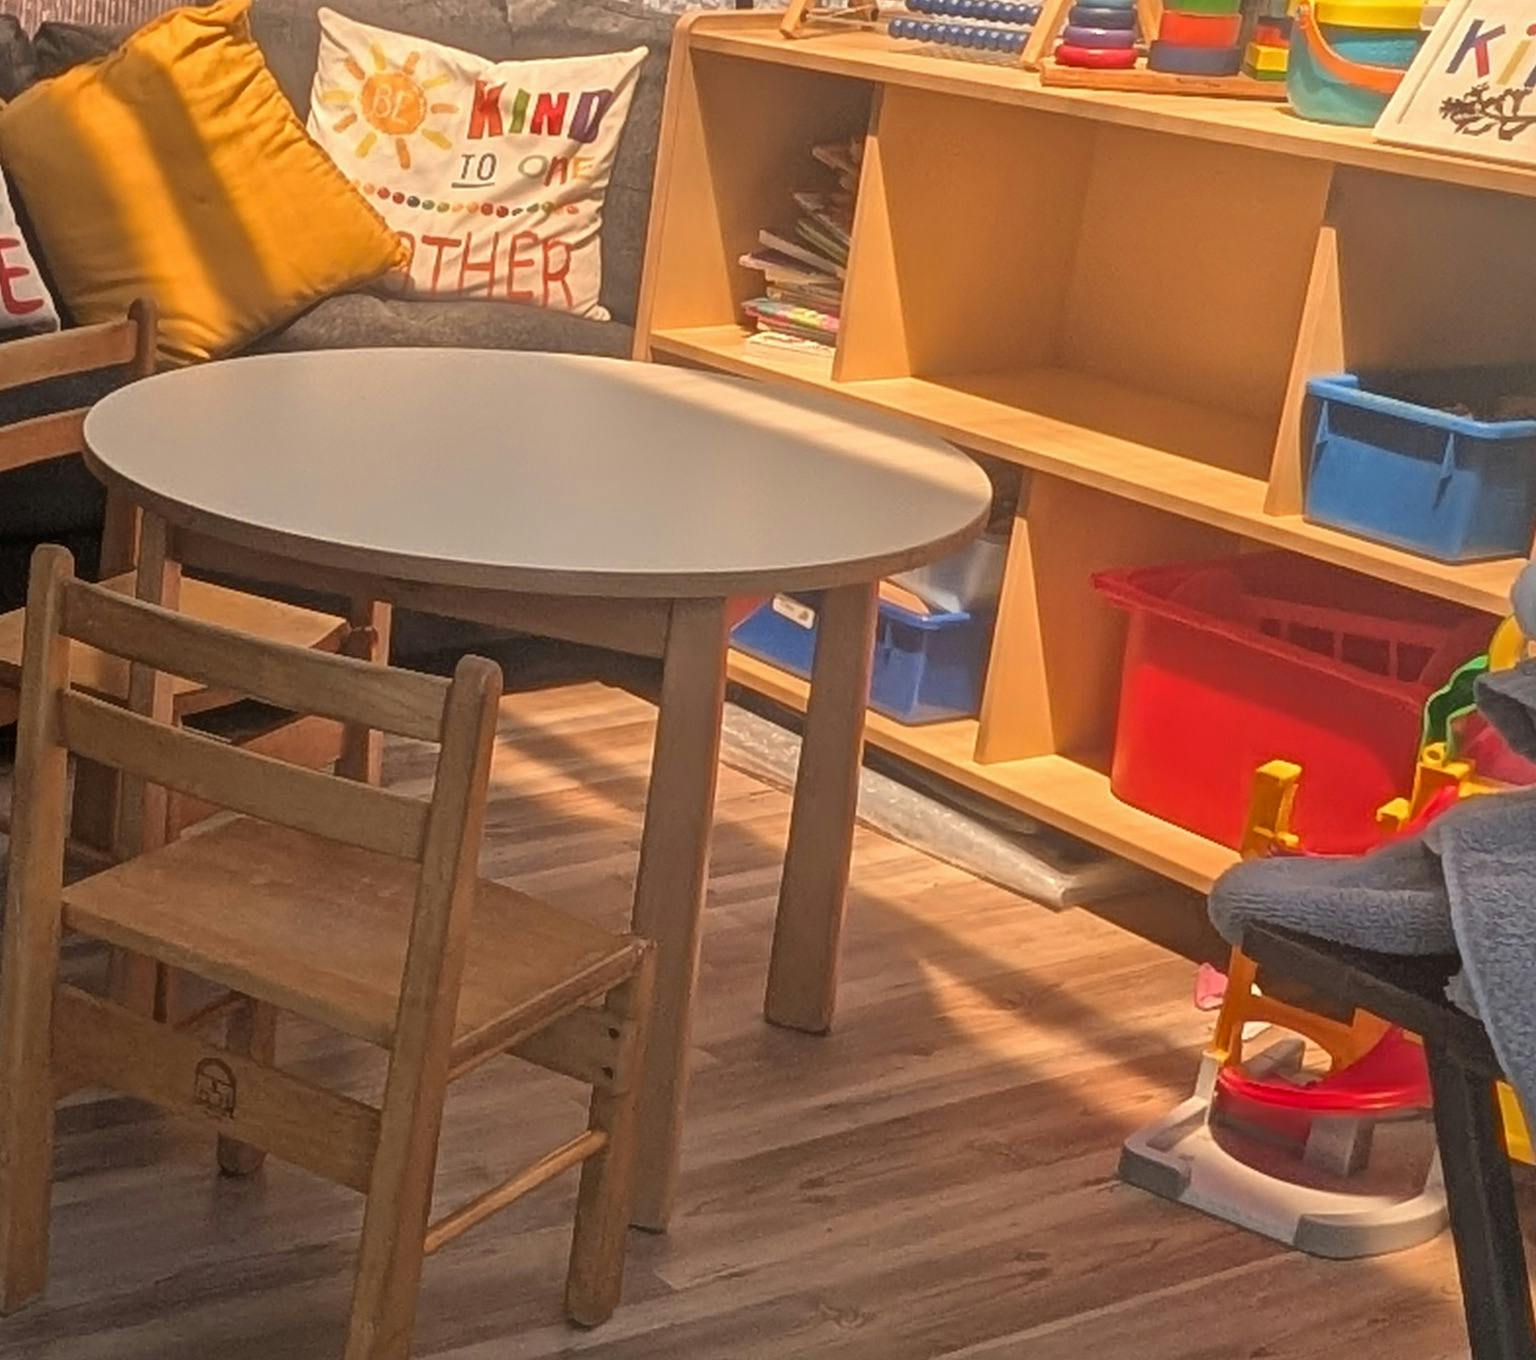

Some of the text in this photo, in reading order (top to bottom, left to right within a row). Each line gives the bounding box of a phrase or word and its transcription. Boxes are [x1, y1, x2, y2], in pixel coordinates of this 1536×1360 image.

[1445, 18, 1536, 88] Ki
[467, 78, 615, 144] KIND
[461, 152, 498, 182] TO
